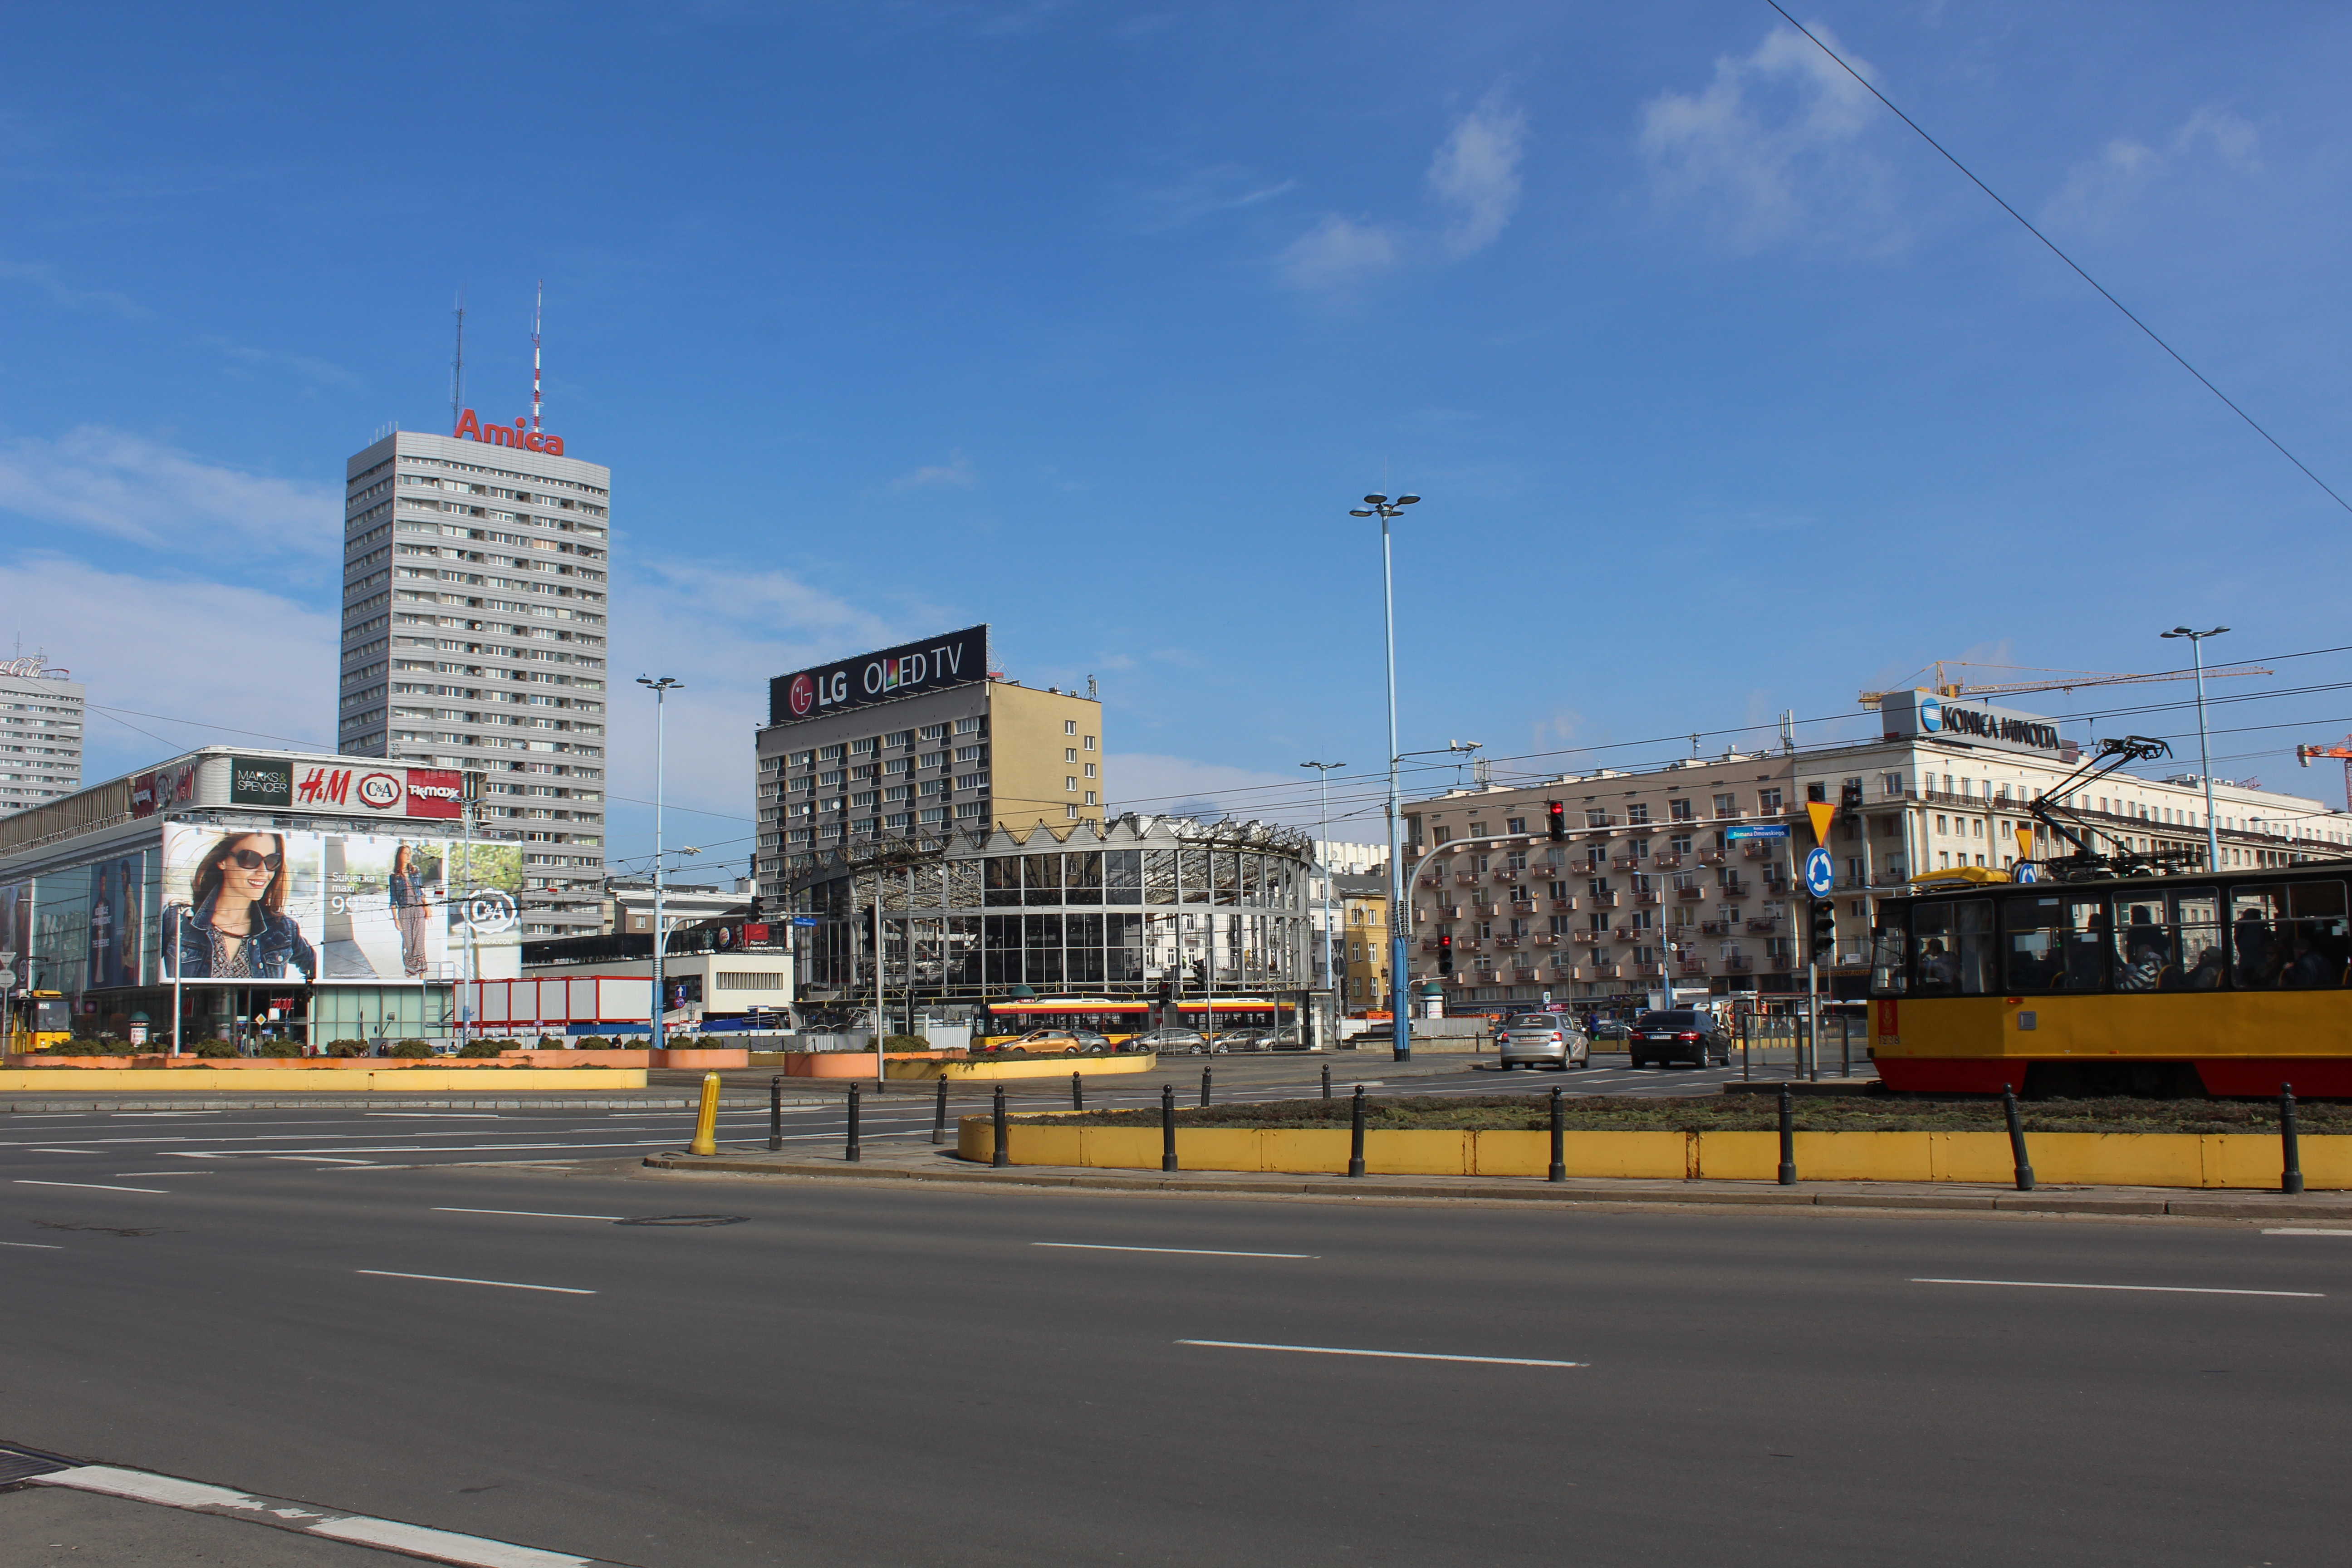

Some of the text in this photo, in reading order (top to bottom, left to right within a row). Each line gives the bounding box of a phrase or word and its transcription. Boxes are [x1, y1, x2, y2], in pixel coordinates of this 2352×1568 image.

[454, 408, 564, 456] Amica
[819, 642, 962, 706] LG OLED TV
[1941, 706, 2060, 750] KONICA MINOLTA
[238, 780, 287, 793] SPENCER
[299, 768, 352, 806] H&M
[366, 781, 394, 798] C&A
[471, 900, 509, 920] C&A
